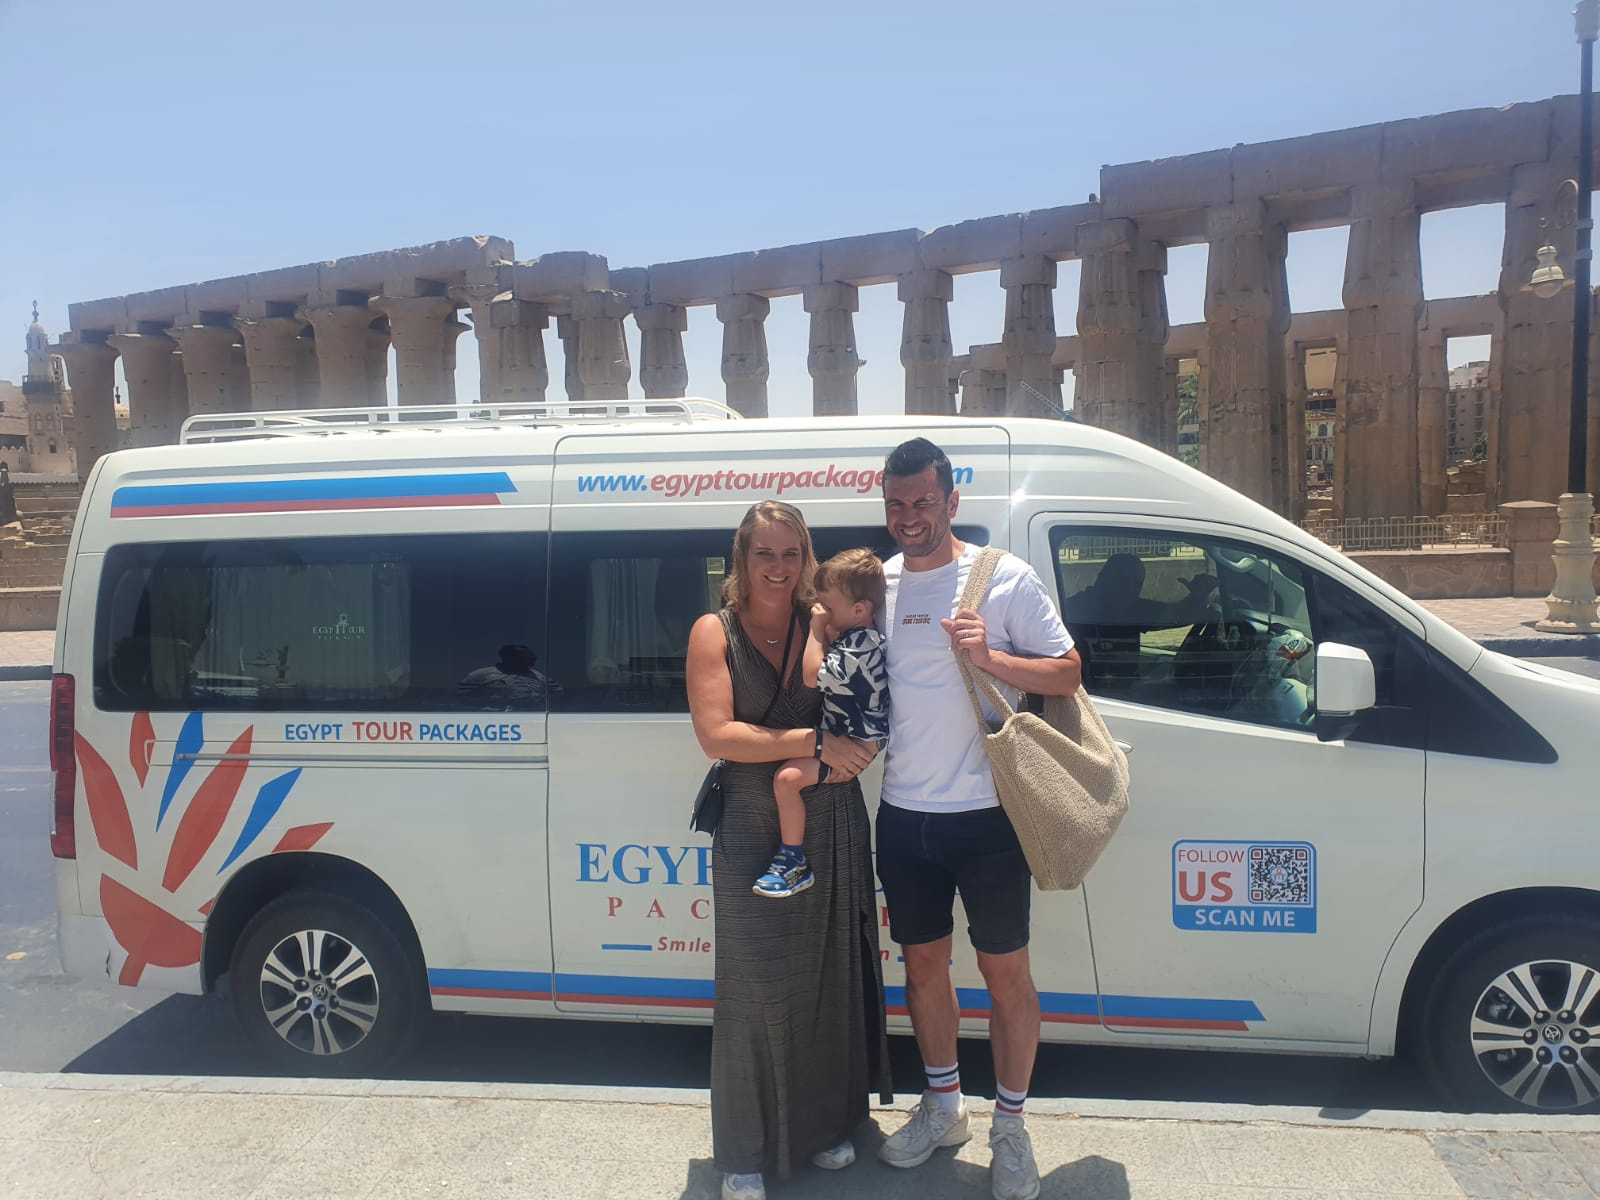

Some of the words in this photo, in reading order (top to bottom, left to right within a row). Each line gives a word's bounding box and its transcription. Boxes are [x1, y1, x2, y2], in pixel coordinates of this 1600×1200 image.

[284, 723, 344, 741] EGYPT
[352, 721, 413, 741] TOUR
[419, 723, 522, 742] PACKAGES
[575, 843, 713, 886] EGYP
[1178, 849, 1245, 863] FOLLOW
[1178, 871, 1234, 903] US
[1194, 908, 1255, 927] SCAN
[1263, 910, 1296, 927] ME
[657, 936, 712, 953] Smile
